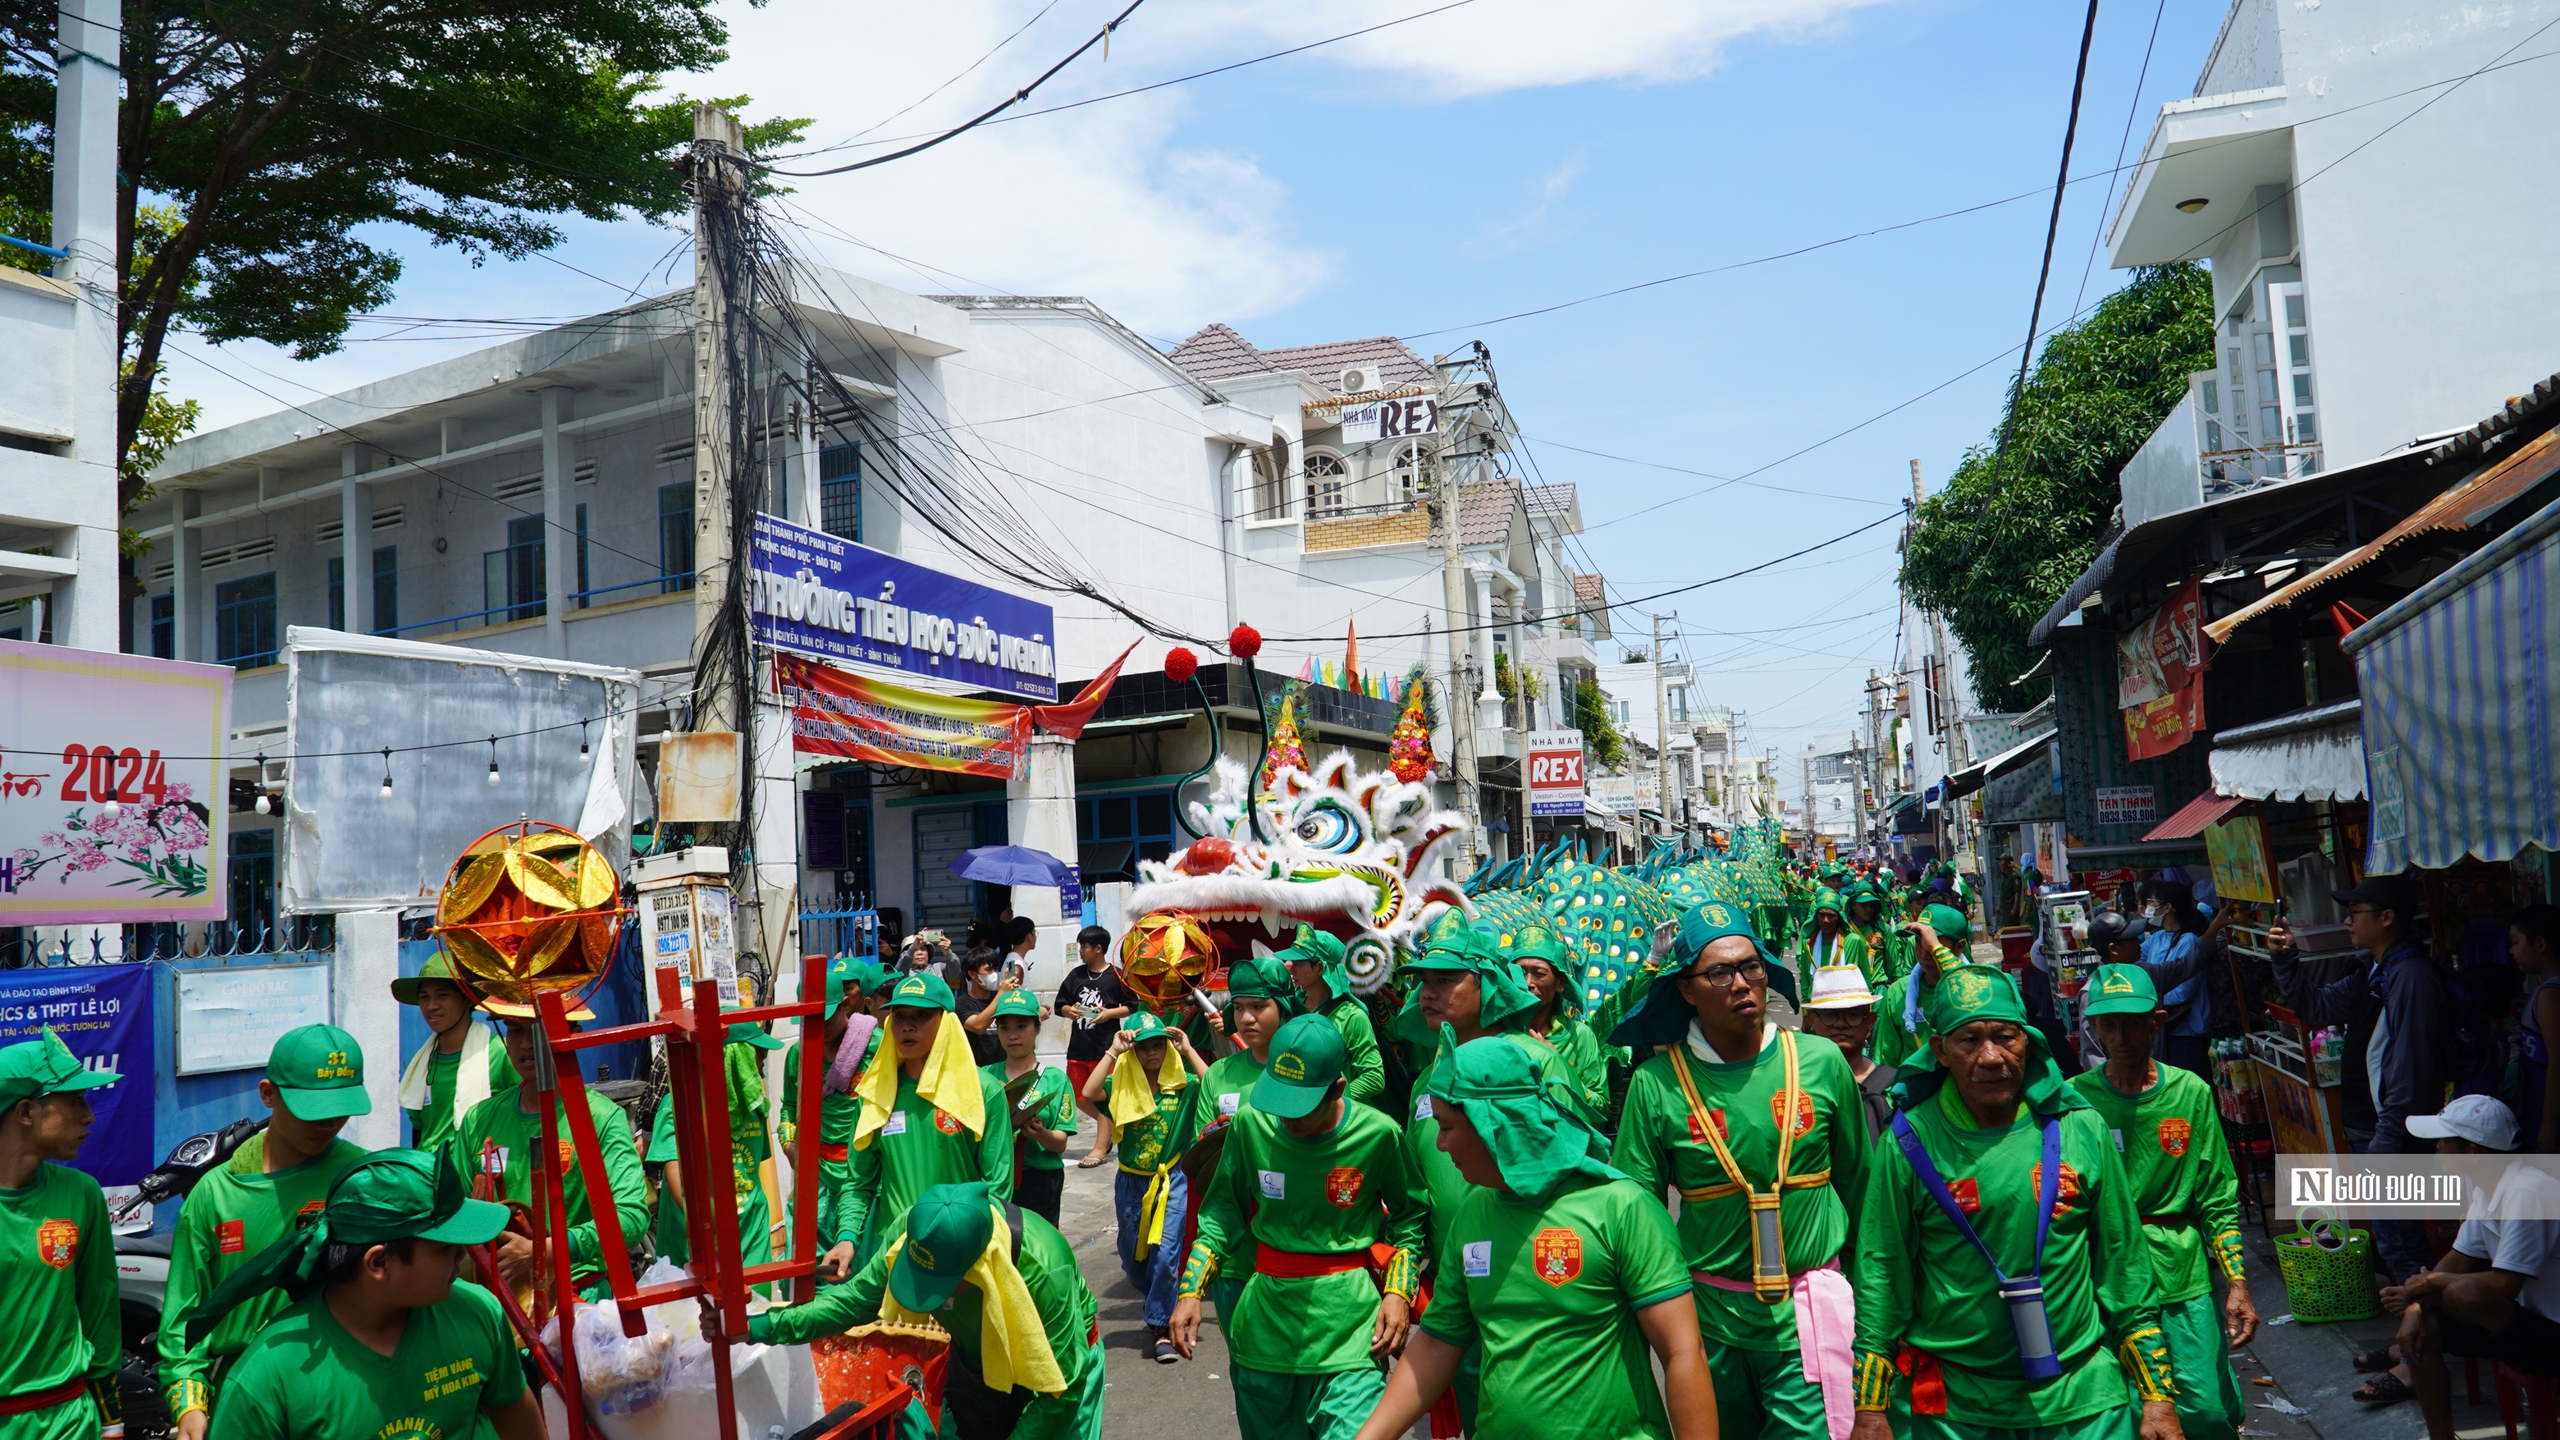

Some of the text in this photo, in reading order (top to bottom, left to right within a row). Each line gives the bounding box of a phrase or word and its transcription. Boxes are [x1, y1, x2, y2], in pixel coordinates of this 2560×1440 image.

[1343, 407, 1378, 424] NHÀ MAY
[771, 523, 794, 542] THÀNH
[794, 531, 809, 546] PHỐ
[809, 536, 826, 551] PHAN
[827, 541, 845, 556] THIẾT
[780, 543, 797, 559] GIÁO
[797, 550, 811, 565] DỤC
[816, 554, 829, 568] ĐÀO
[830, 561, 842, 574] TẠO
[857, 580, 909, 646] TIỂU
[910, 610, 956, 666] HỌC
[957, 615, 999, 666] ĐỨC
[1000, 633, 1056, 679] NGHĨA
[800, 635, 814, 647] VĂN
[828, 641, 845, 654] PHAN
[846, 644, 863, 658] THIẾT
[882, 652, 902, 668] THUẬN
[1531, 736, 1580, 747] NHÀ MAY
[60, 743, 167, 806] 2024
[1532, 756, 1581, 783] REX
[2100, 809, 2155, 823] 0933.963.906
[12, 987, 31, 998] ĐÀO
[32, 988, 48, 998] TẠO
[49, 985, 69, 996] BÌNH
[70, 983, 96, 996] THUẬN
[0, 997, 120, 1021] HCS & THPT LÊ LỢI
[3, 1026, 17, 1036] TÀI
[72, 1021, 99, 1031] TƯƠNG
[99, 1020, 111, 1029] LAI
[327, 1051, 347, 1066] 37
[424, 1357, 473, 1384] TIỆM VÀNG
[441, 1379, 462, 1396] HOA
[461, 1371, 480, 1388] KIM
[378, 1416, 425, 1440] THANH
